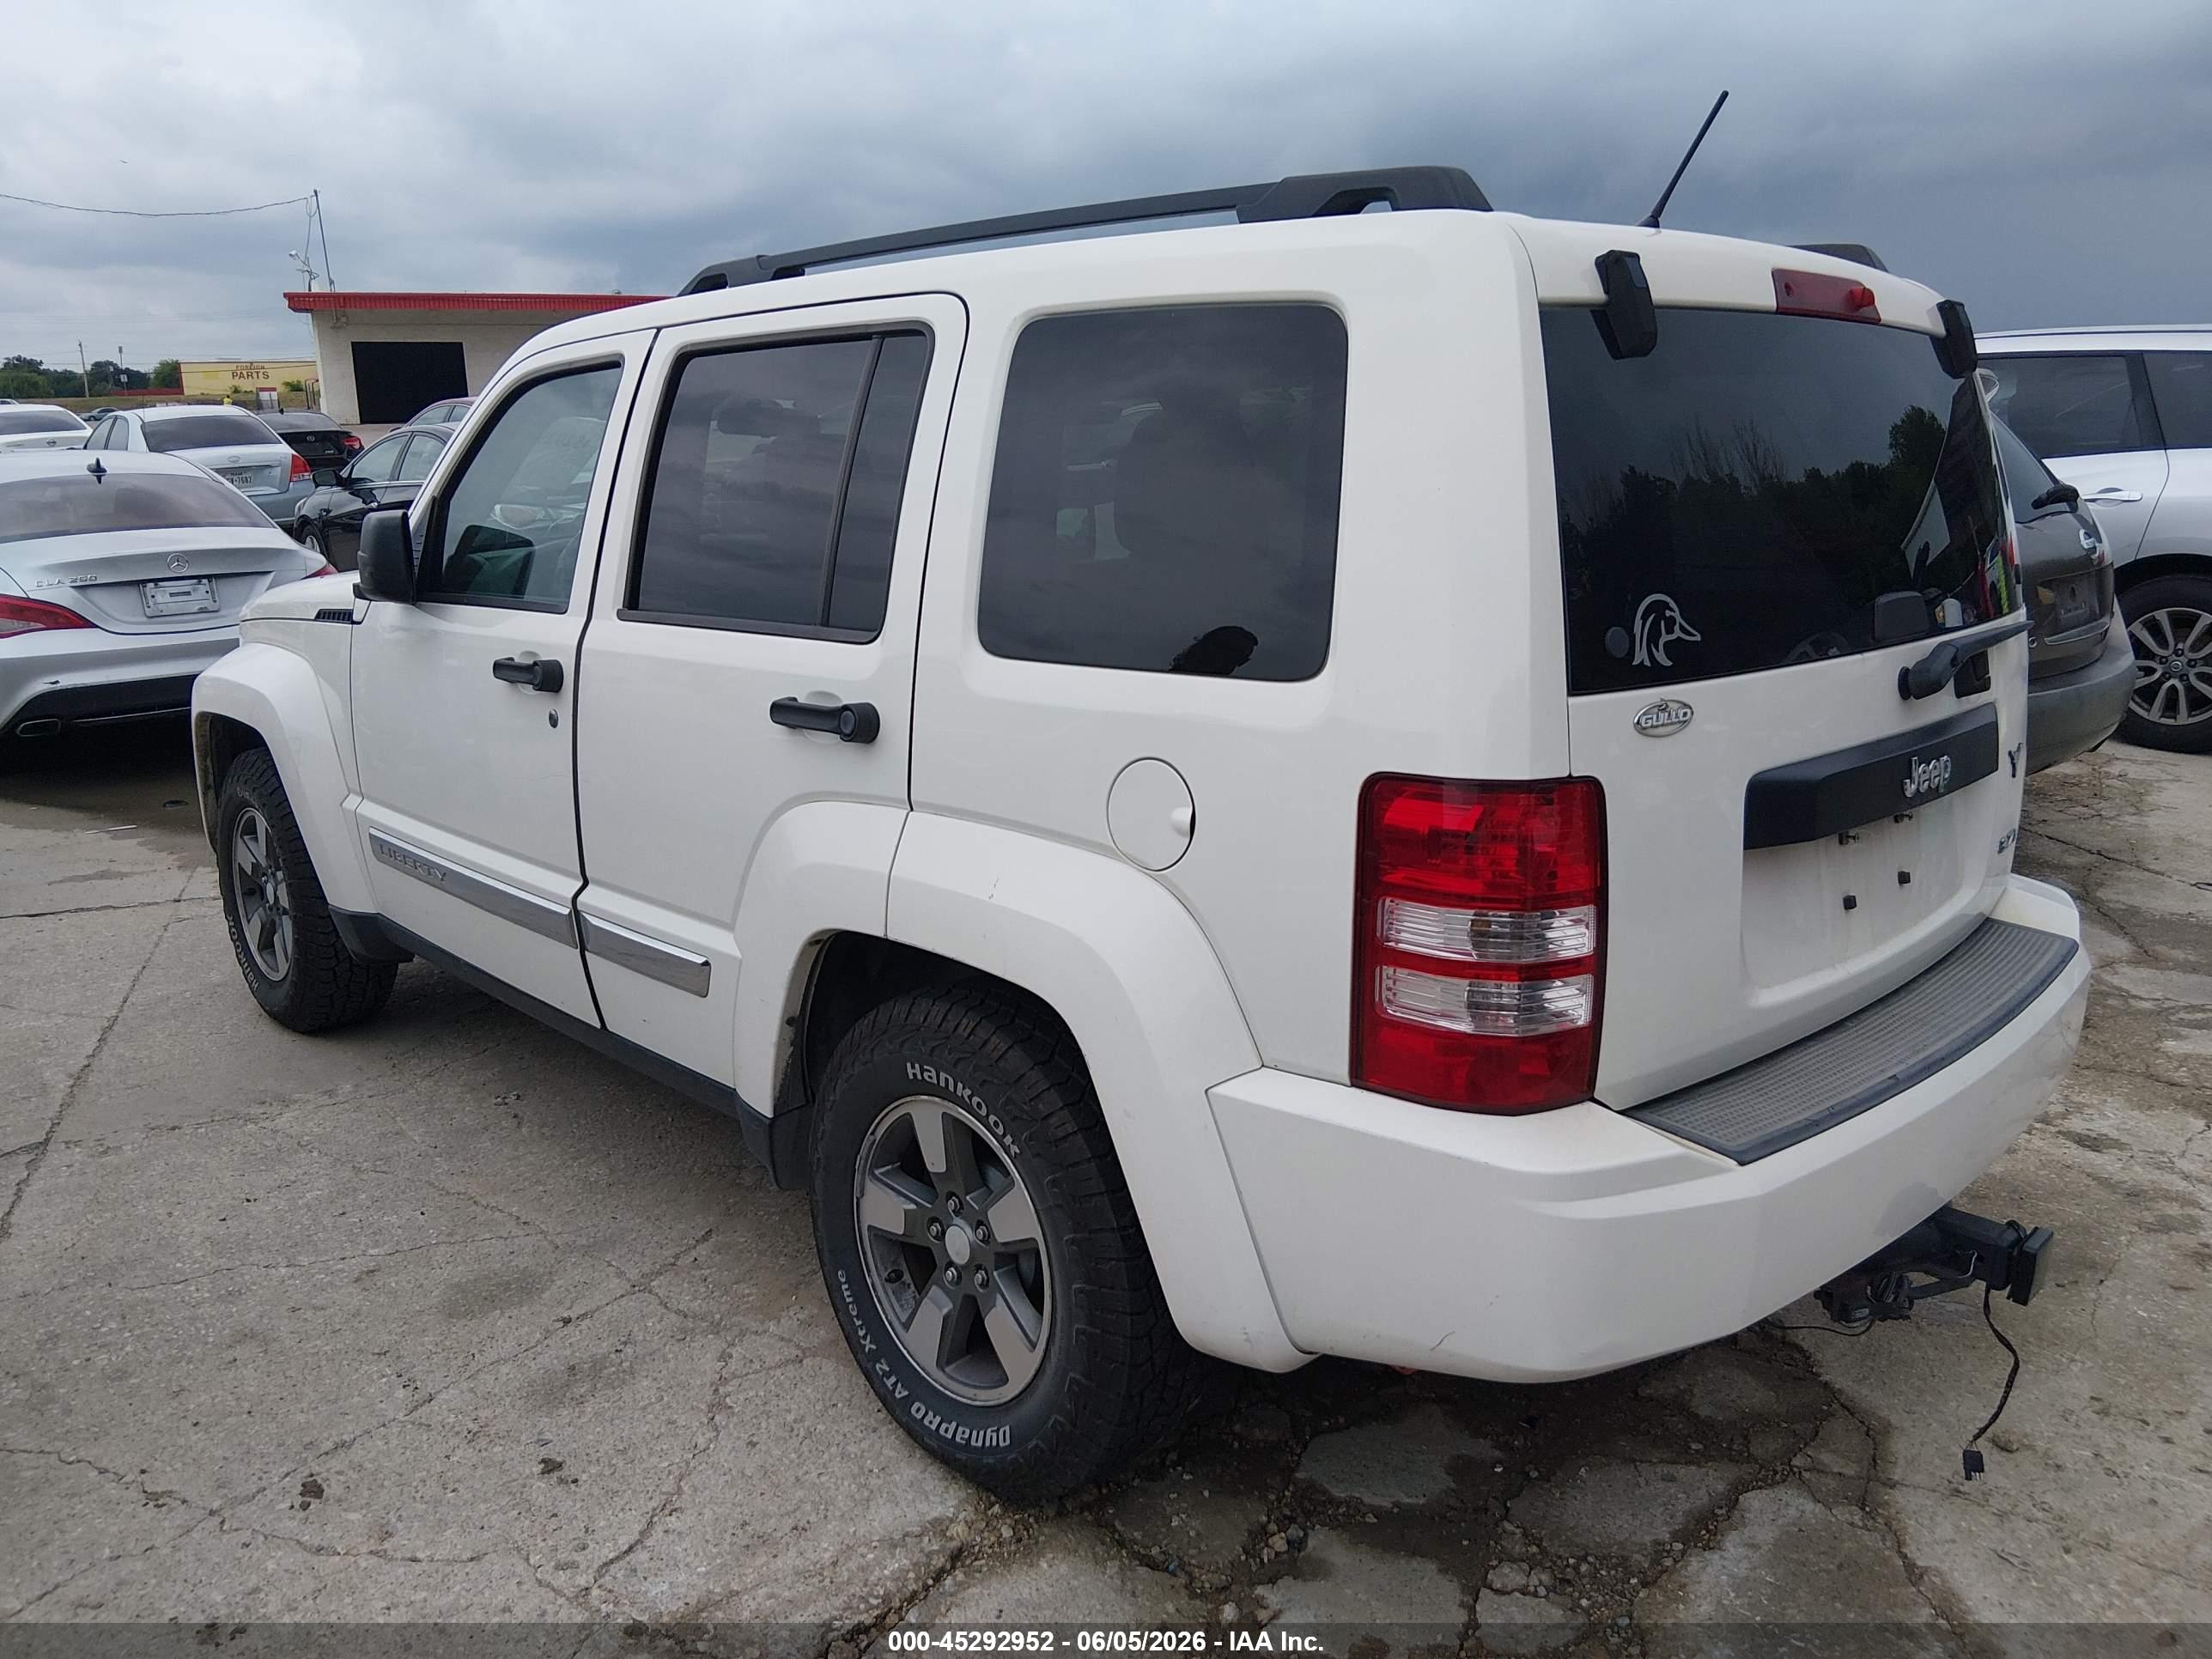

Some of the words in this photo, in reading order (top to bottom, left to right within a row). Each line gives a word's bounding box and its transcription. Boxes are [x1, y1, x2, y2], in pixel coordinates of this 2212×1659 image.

[232, 370, 270, 380] PARTS
[34, 579, 66, 587] CLA
[1640, 708, 1692, 728] GULLO
[1903, 755, 1952, 798] Jeep
[379, 843, 447, 882] LIBERTY
[837, 1268, 878, 1354] Xtreme
[875, 1358, 909, 1400] AT2
